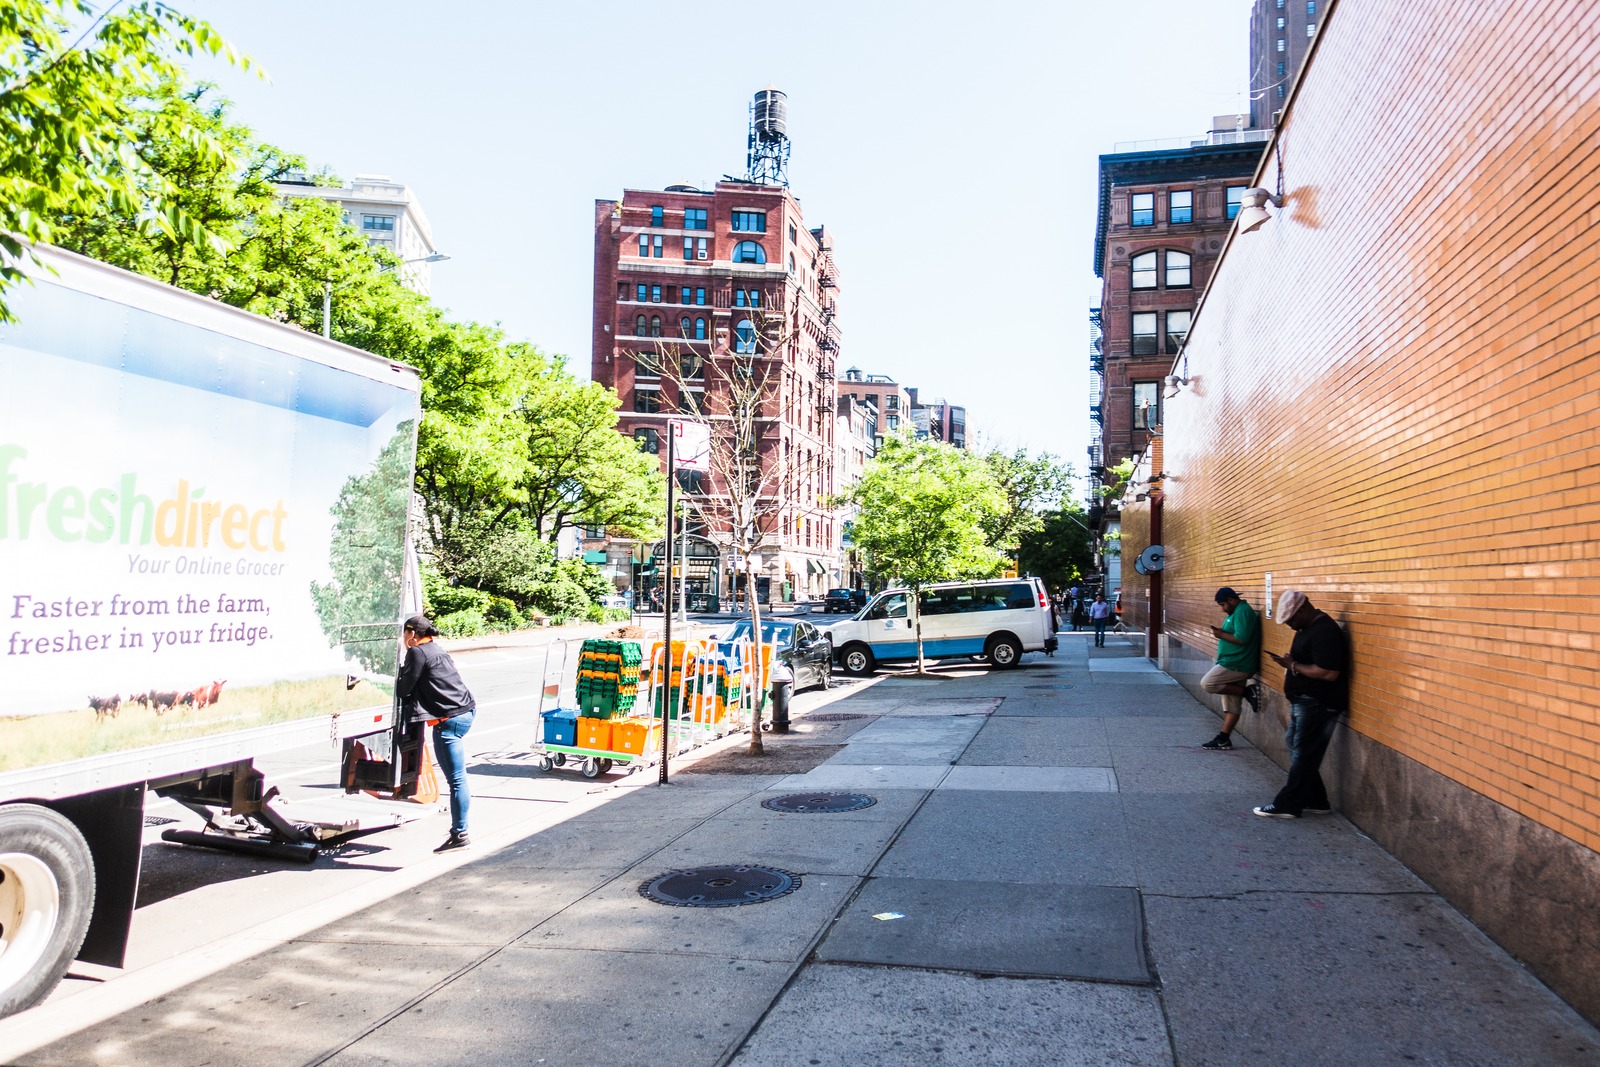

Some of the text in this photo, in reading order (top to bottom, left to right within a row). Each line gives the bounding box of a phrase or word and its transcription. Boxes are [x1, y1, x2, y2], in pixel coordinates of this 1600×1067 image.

[127, 554, 285, 576] Your Online Grocer
[11, 593, 271, 618] Faster from the farm,
[8, 622, 273, 655] fresher in your fridge.
